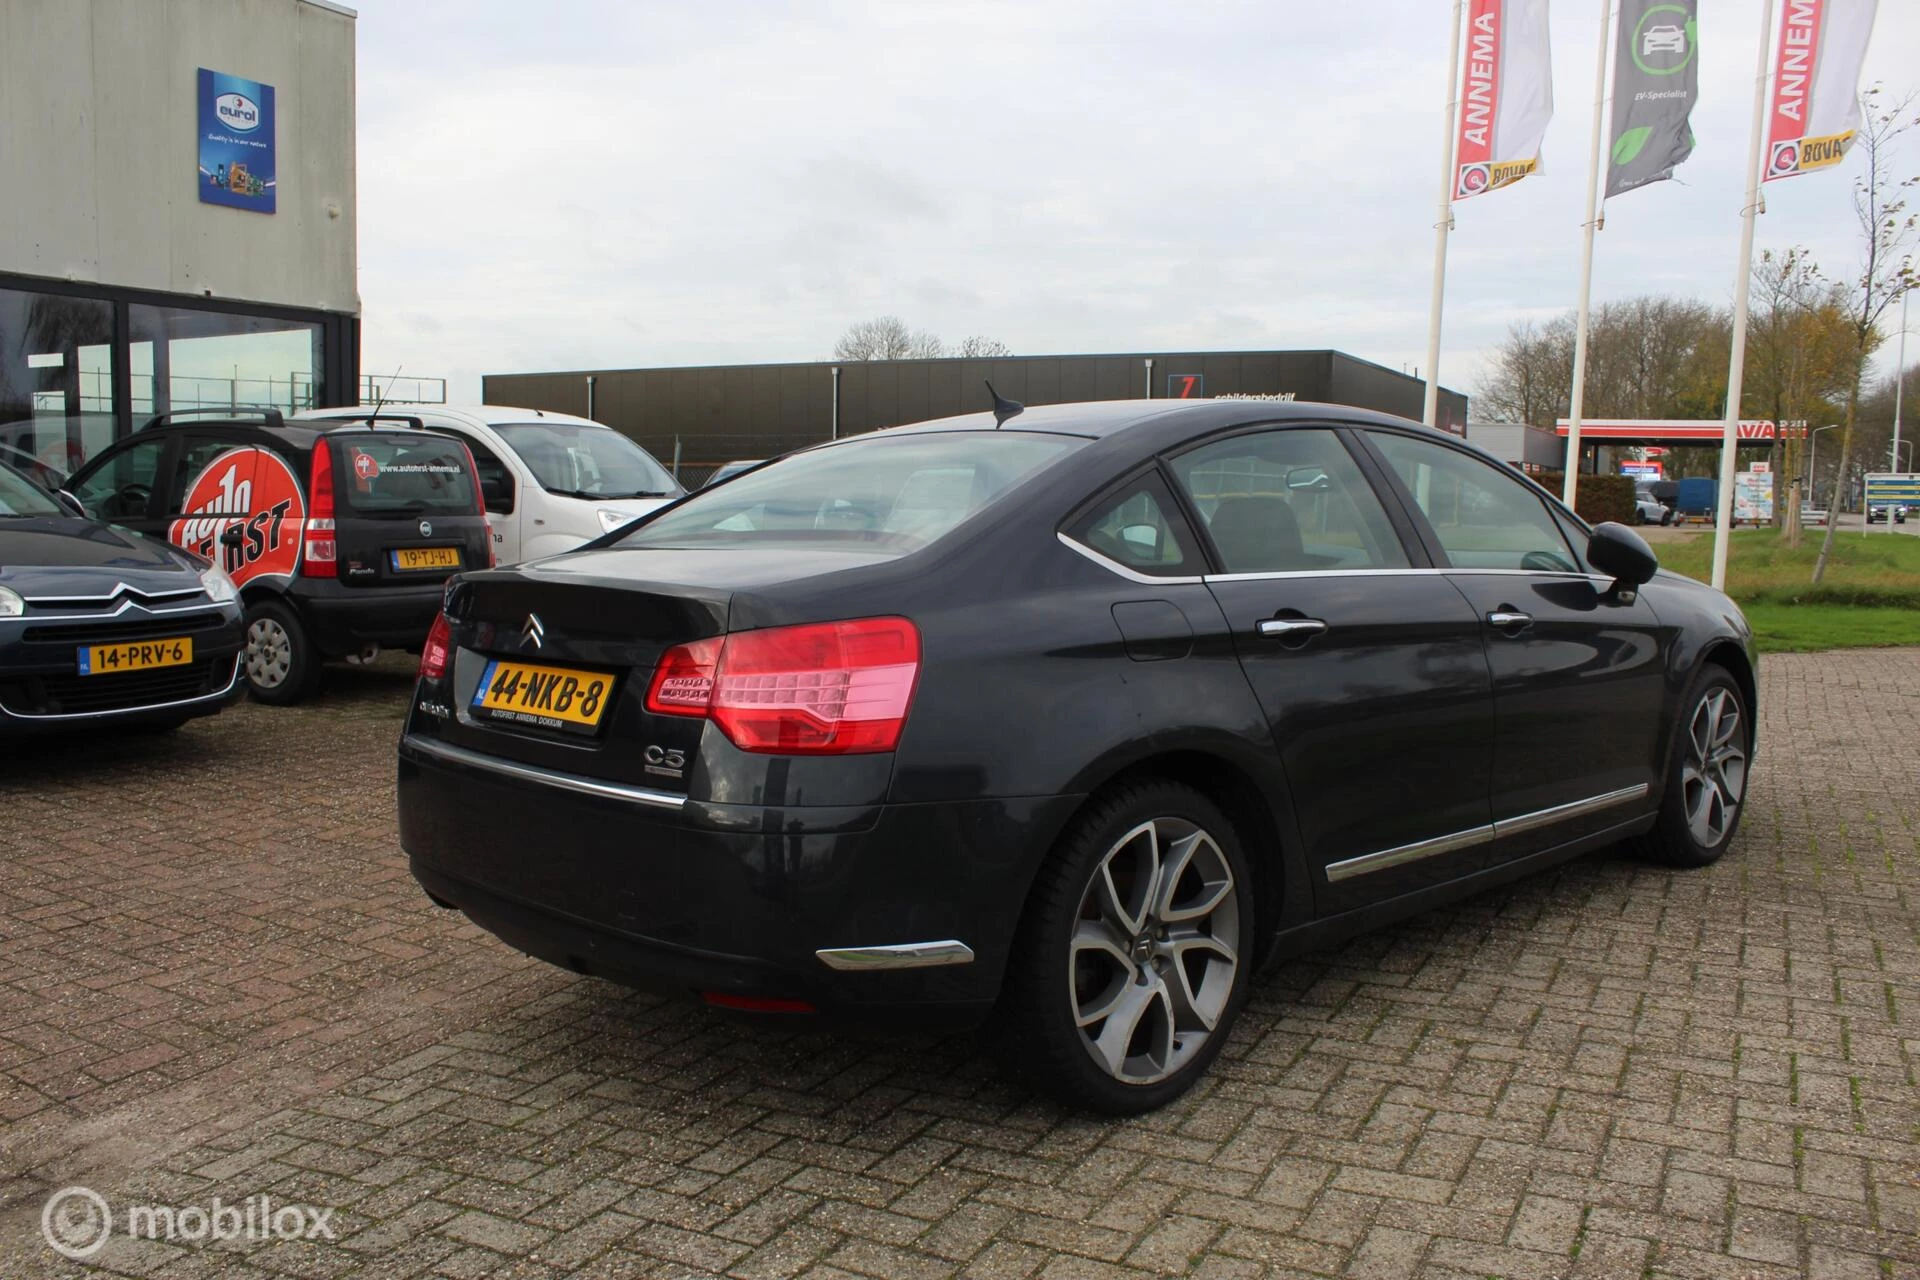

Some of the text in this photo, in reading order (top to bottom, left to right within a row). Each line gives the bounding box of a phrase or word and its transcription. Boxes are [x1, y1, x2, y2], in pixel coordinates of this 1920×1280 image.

[1778, 0, 1816, 121] ANNEM
[1464, 12, 1495, 146] ANNEMA
[220, 106, 256, 121] eurol
[1803, 136, 1850, 163] BOVA
[1737, 423, 1775, 438] VIA
[404, 550, 453, 566] 19-TJ-HJ
[98, 642, 184, 669] 14-PRV-6
[491, 669, 604, 717] 44-NKB-8
[515, 713, 537, 724] ANNEMA
[538, 717, 563, 728] DOKKUM
[644, 745, 684, 768] C5
